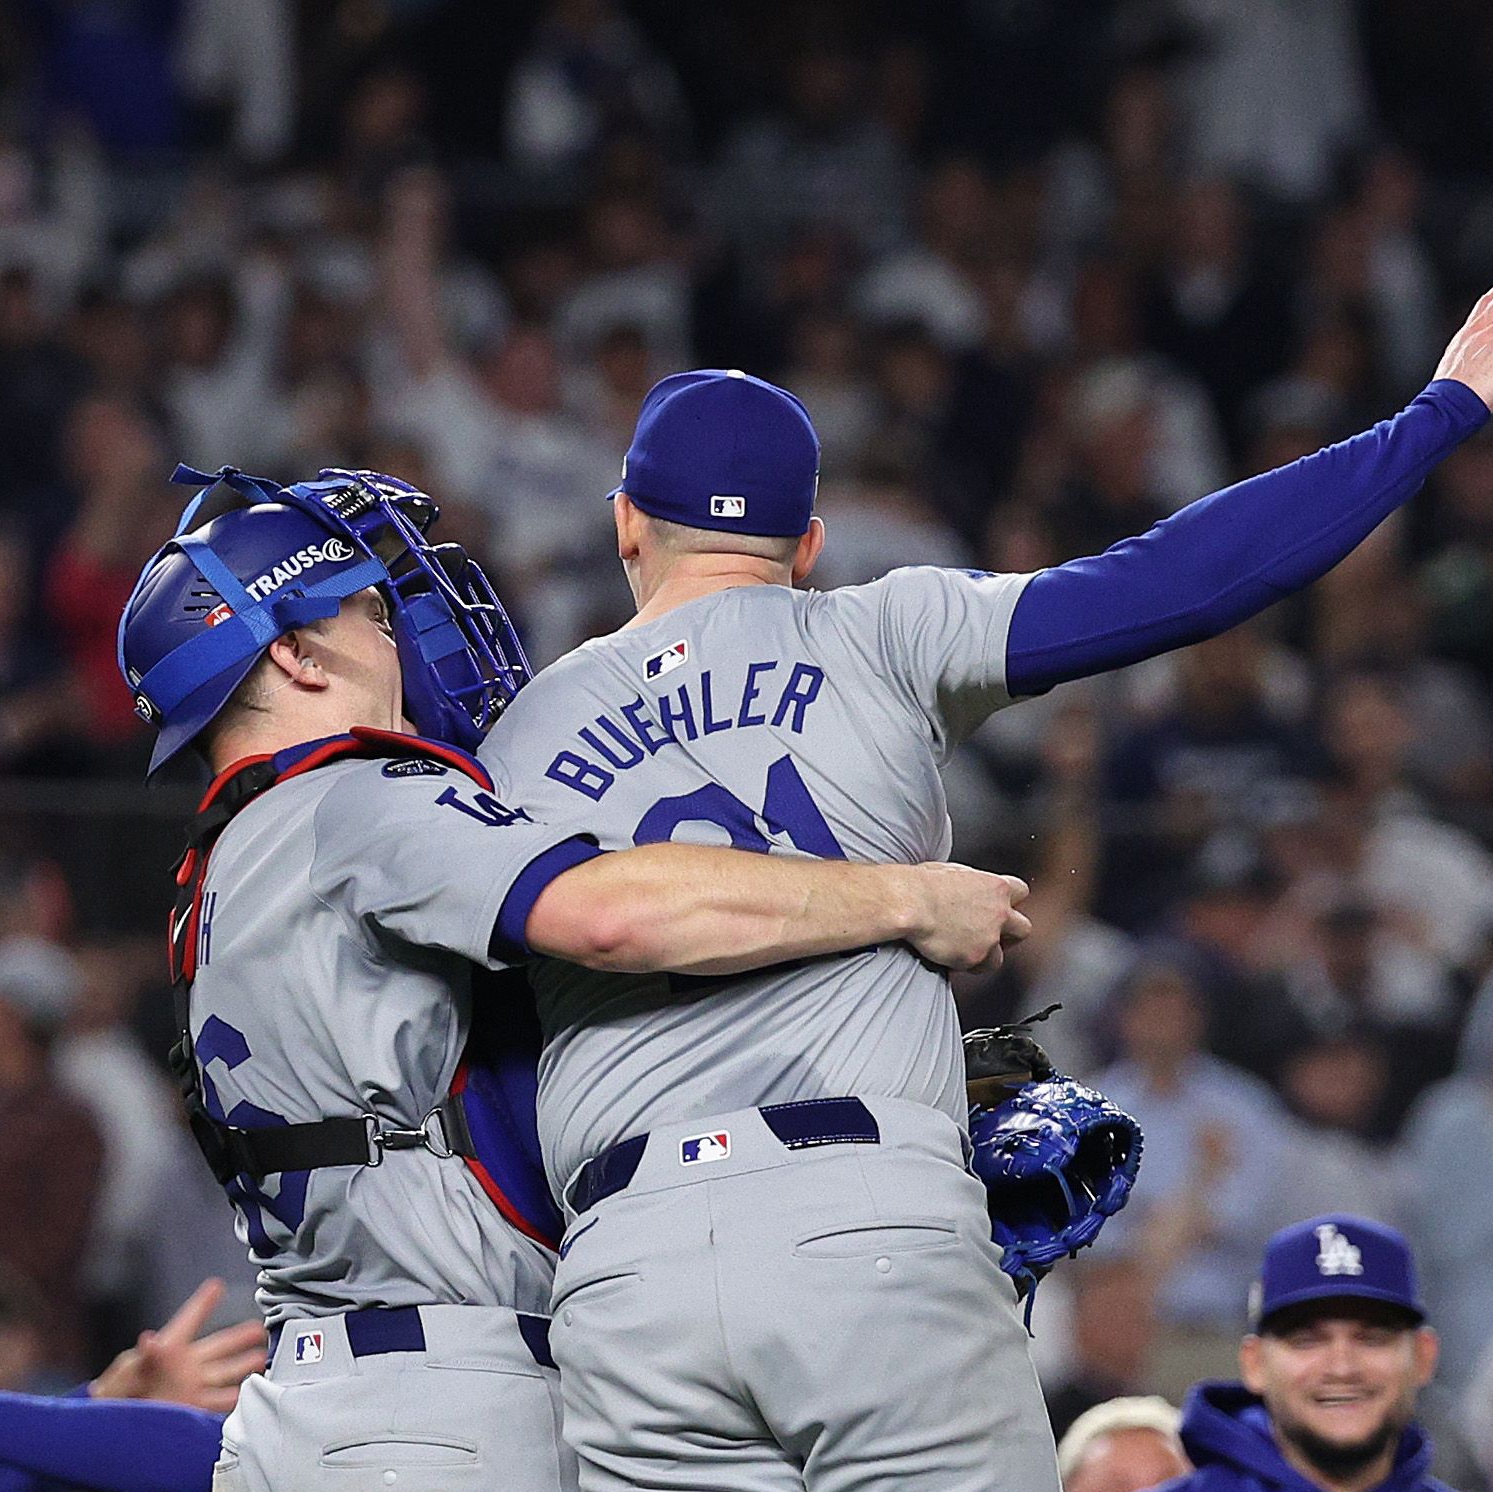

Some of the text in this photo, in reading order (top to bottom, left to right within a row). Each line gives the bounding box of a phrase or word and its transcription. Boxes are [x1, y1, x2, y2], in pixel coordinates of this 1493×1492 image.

[245, 544, 324, 602] TRAUSS
[544, 660, 826, 802] BUEHLER
[1315, 1223, 1365, 1276] LA
